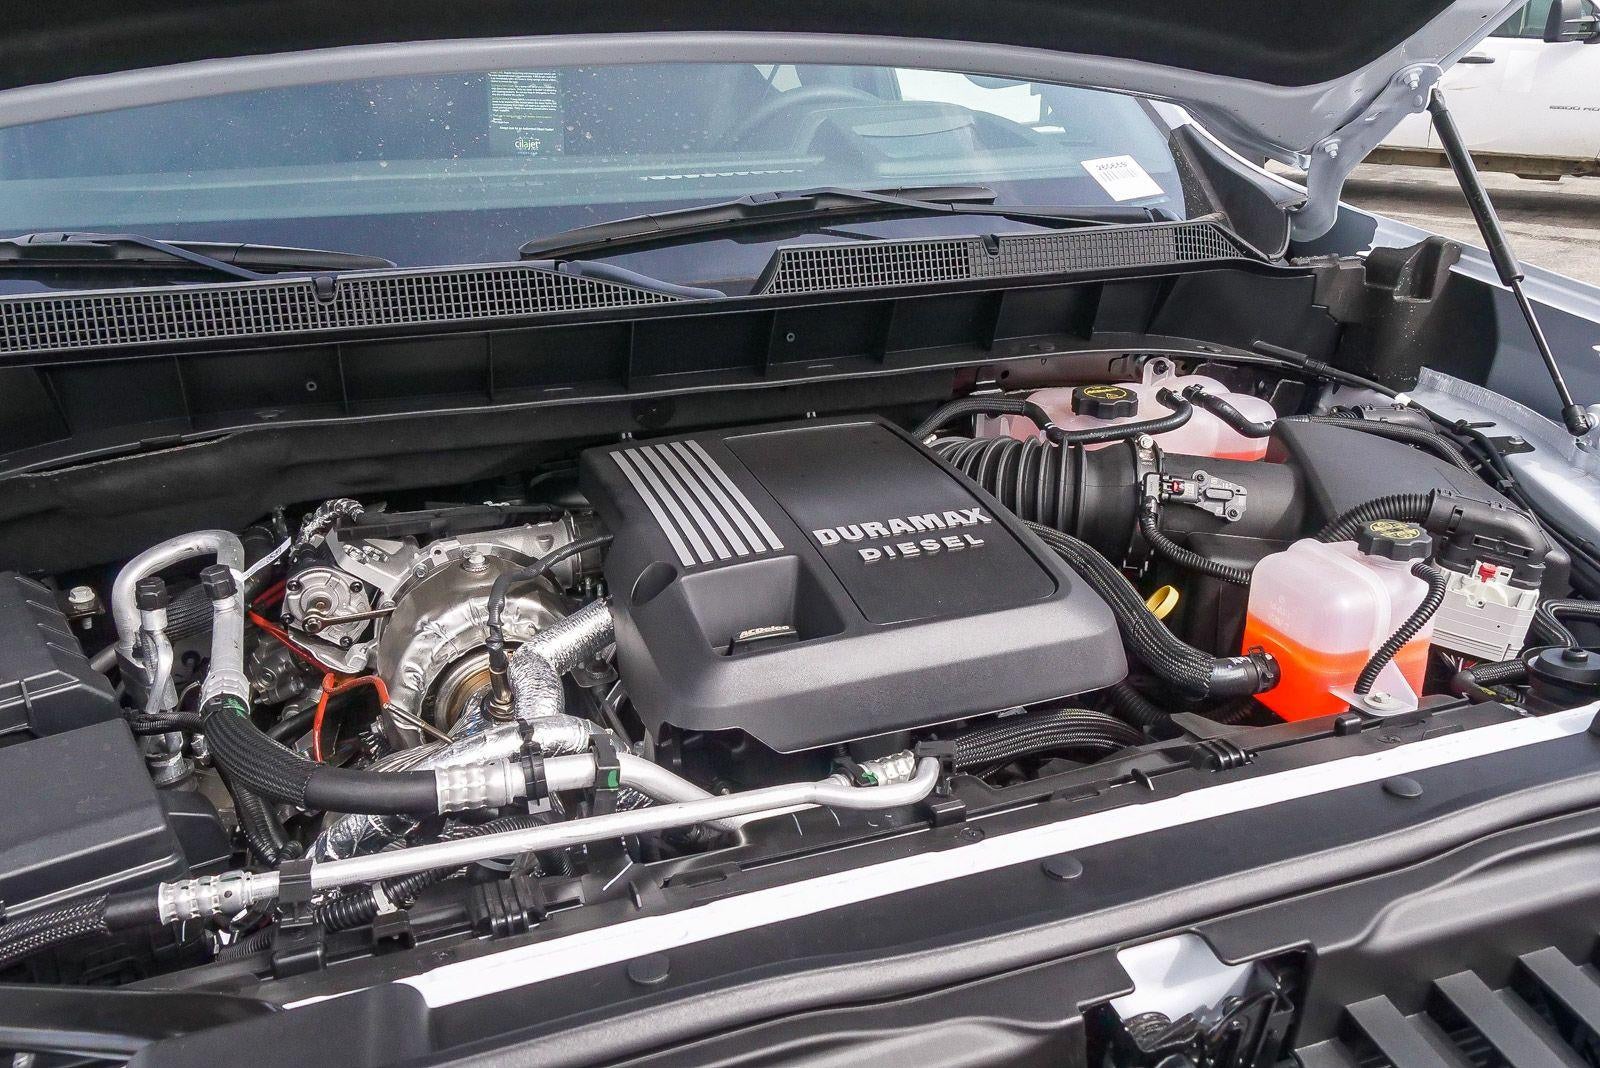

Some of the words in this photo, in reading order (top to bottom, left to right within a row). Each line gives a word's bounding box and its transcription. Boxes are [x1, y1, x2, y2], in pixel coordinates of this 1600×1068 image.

[514, 138, 539, 151] cilajet
[812, 508, 992, 546] DURAMAX
[858, 533, 984, 563] DIESEL
[739, 625, 790, 640] ACDelco
